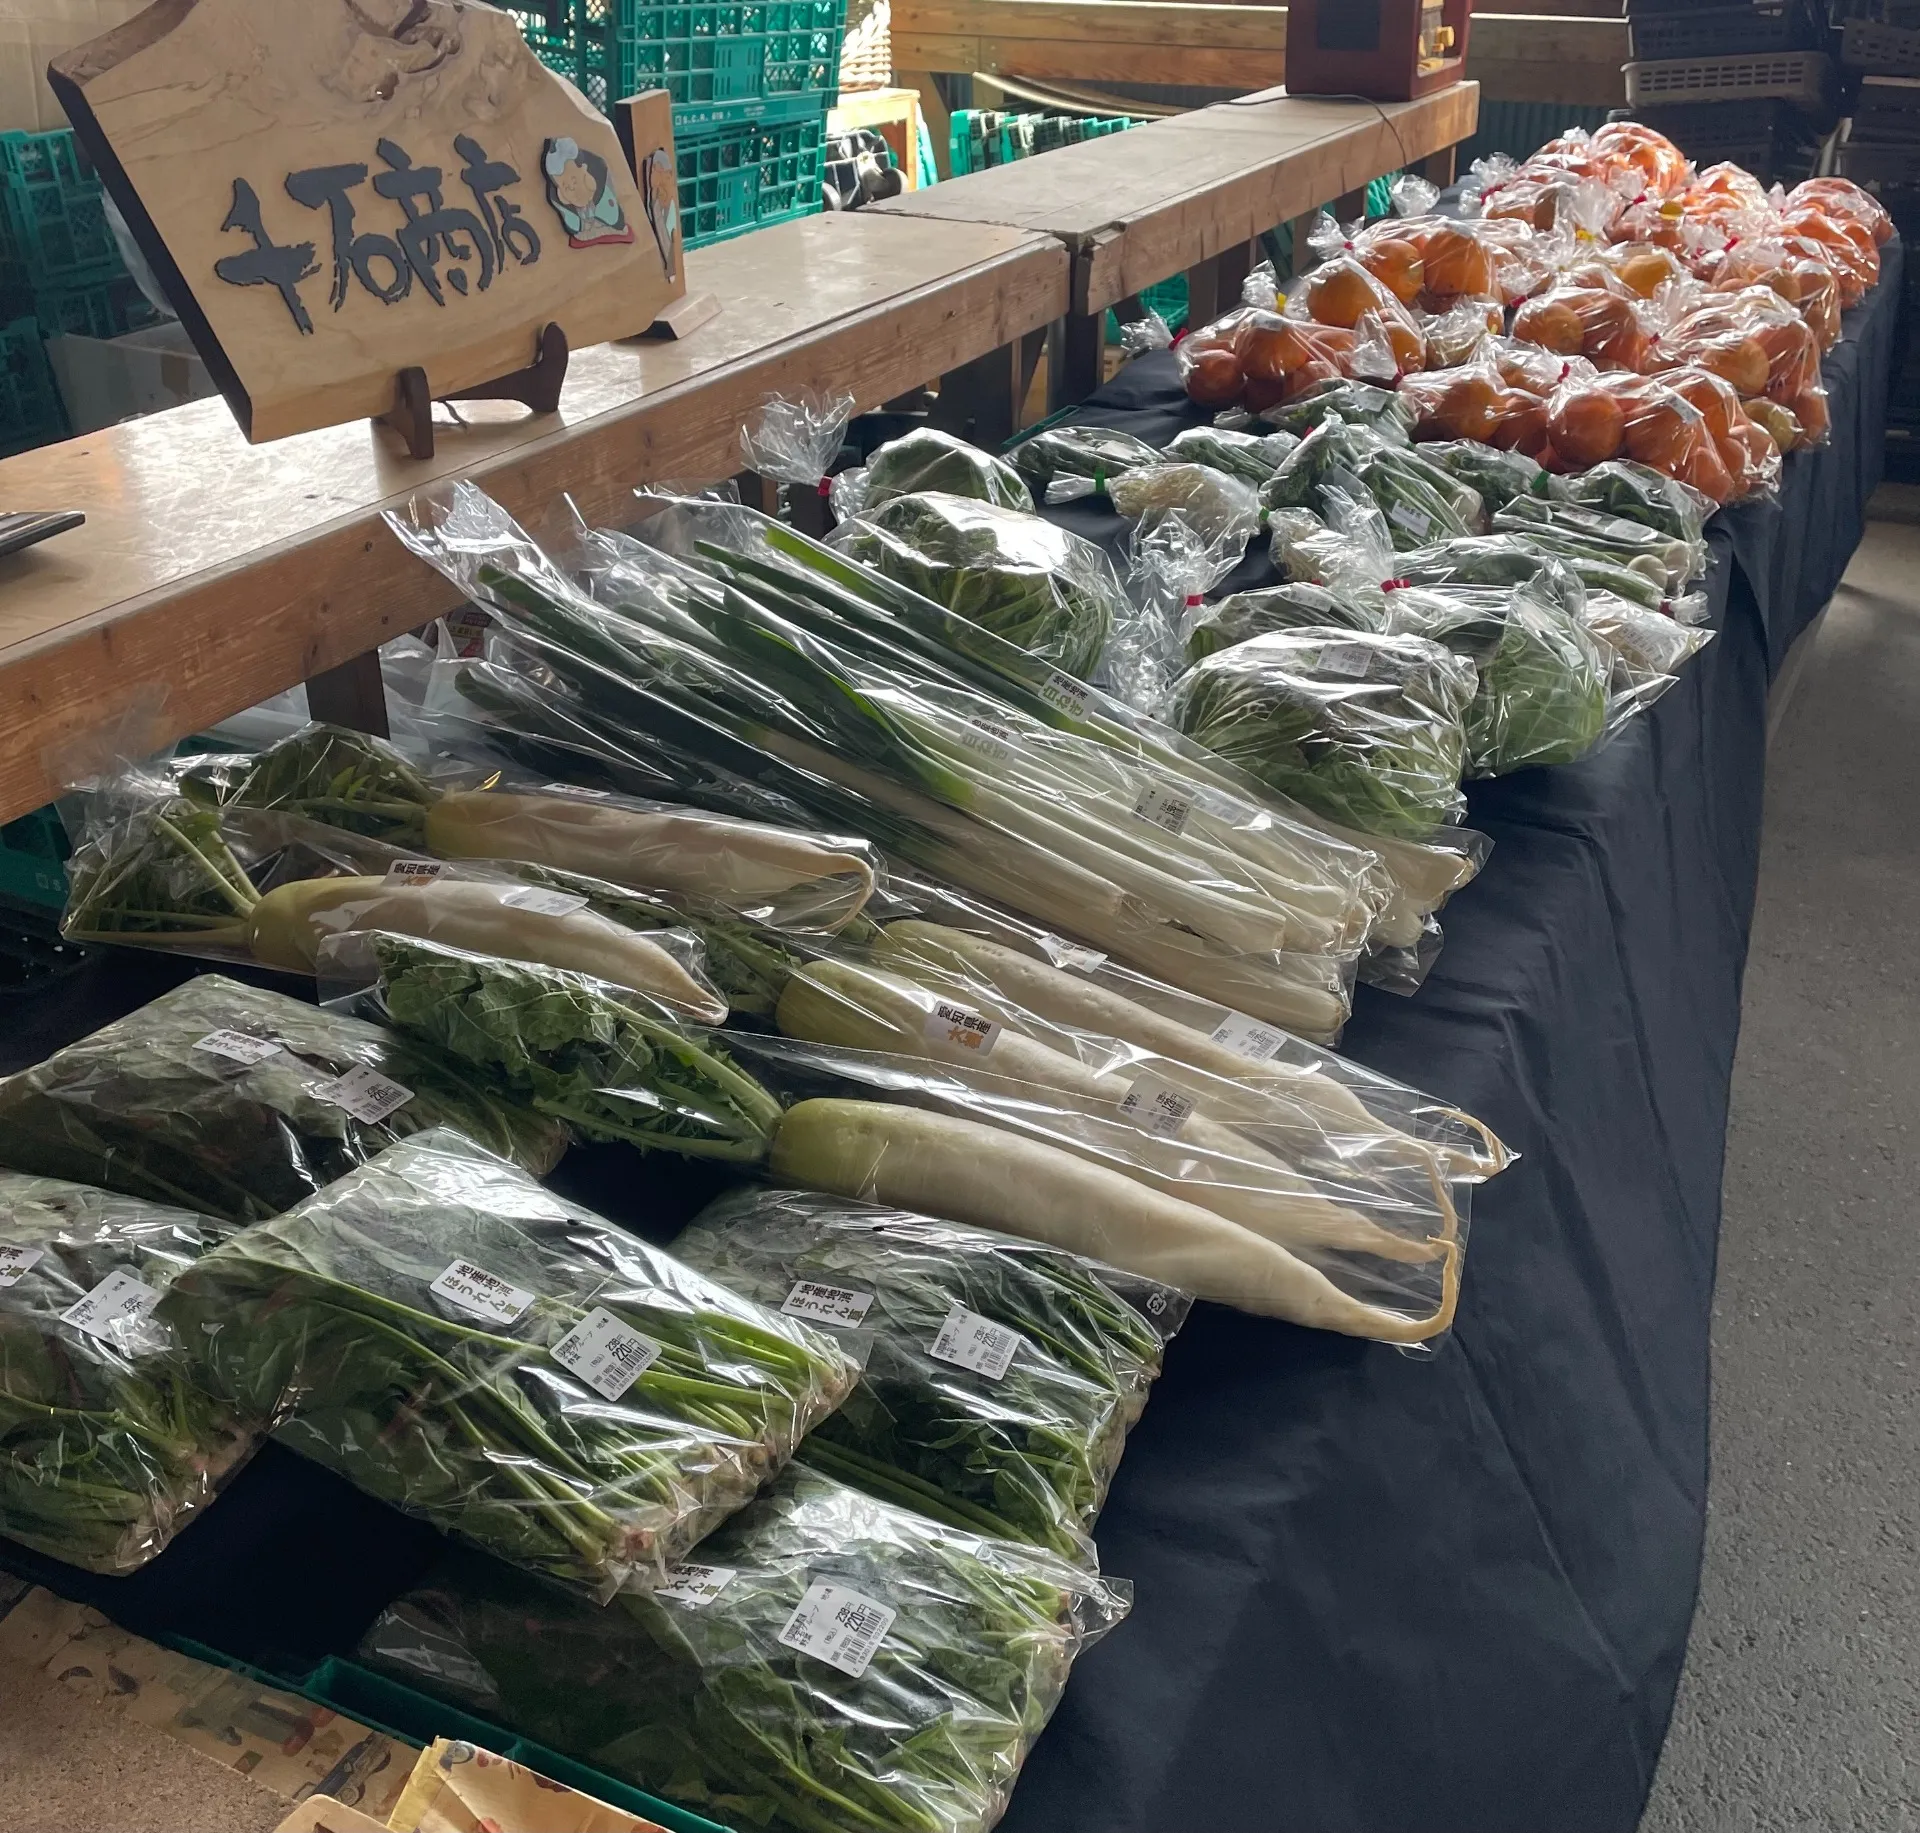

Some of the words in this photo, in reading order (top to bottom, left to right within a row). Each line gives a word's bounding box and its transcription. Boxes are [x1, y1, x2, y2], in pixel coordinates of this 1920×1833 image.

[937, 1005, 992, 1035] 愛知県産
[454, 1264, 515, 1298] 地産地消
[798, 1283, 855, 1304] 地産地消
[440, 1274, 522, 1318] ほうれん草
[788, 1296, 865, 1322] ほうれん草
[604, 1333, 626, 1352] 238円
[611, 1337, 640, 1362] 220円
[835, 1601, 855, 1623] 238円
[843, 1603, 871, 1633] 220円
